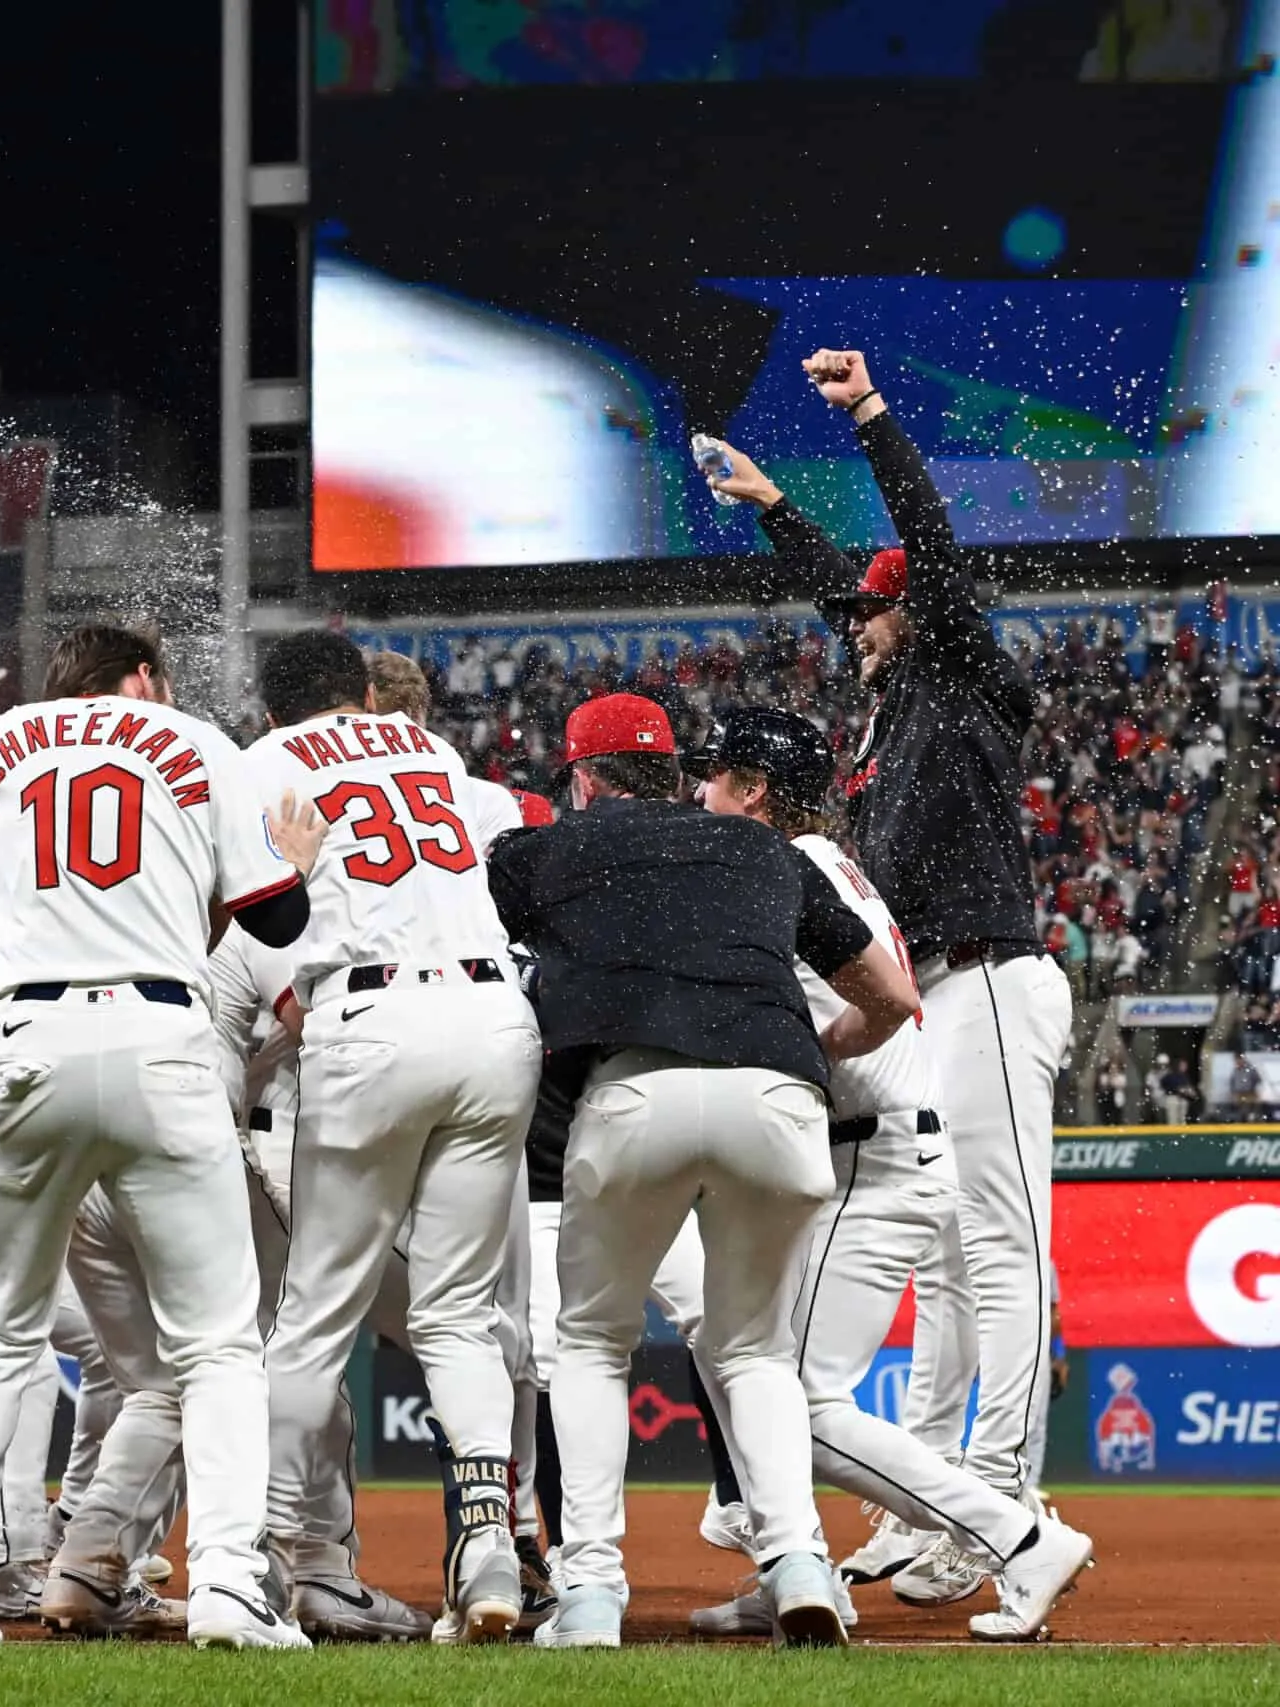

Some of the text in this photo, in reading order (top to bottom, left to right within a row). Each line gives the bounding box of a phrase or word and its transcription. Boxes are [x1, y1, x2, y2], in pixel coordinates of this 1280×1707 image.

[282, 722, 437, 772] VALERA
[20, 762, 145, 891] 10
[312, 771, 478, 887] 35
[1186, 1202, 1280, 1346] G
[1176, 1391, 1280, 1445] SHE
